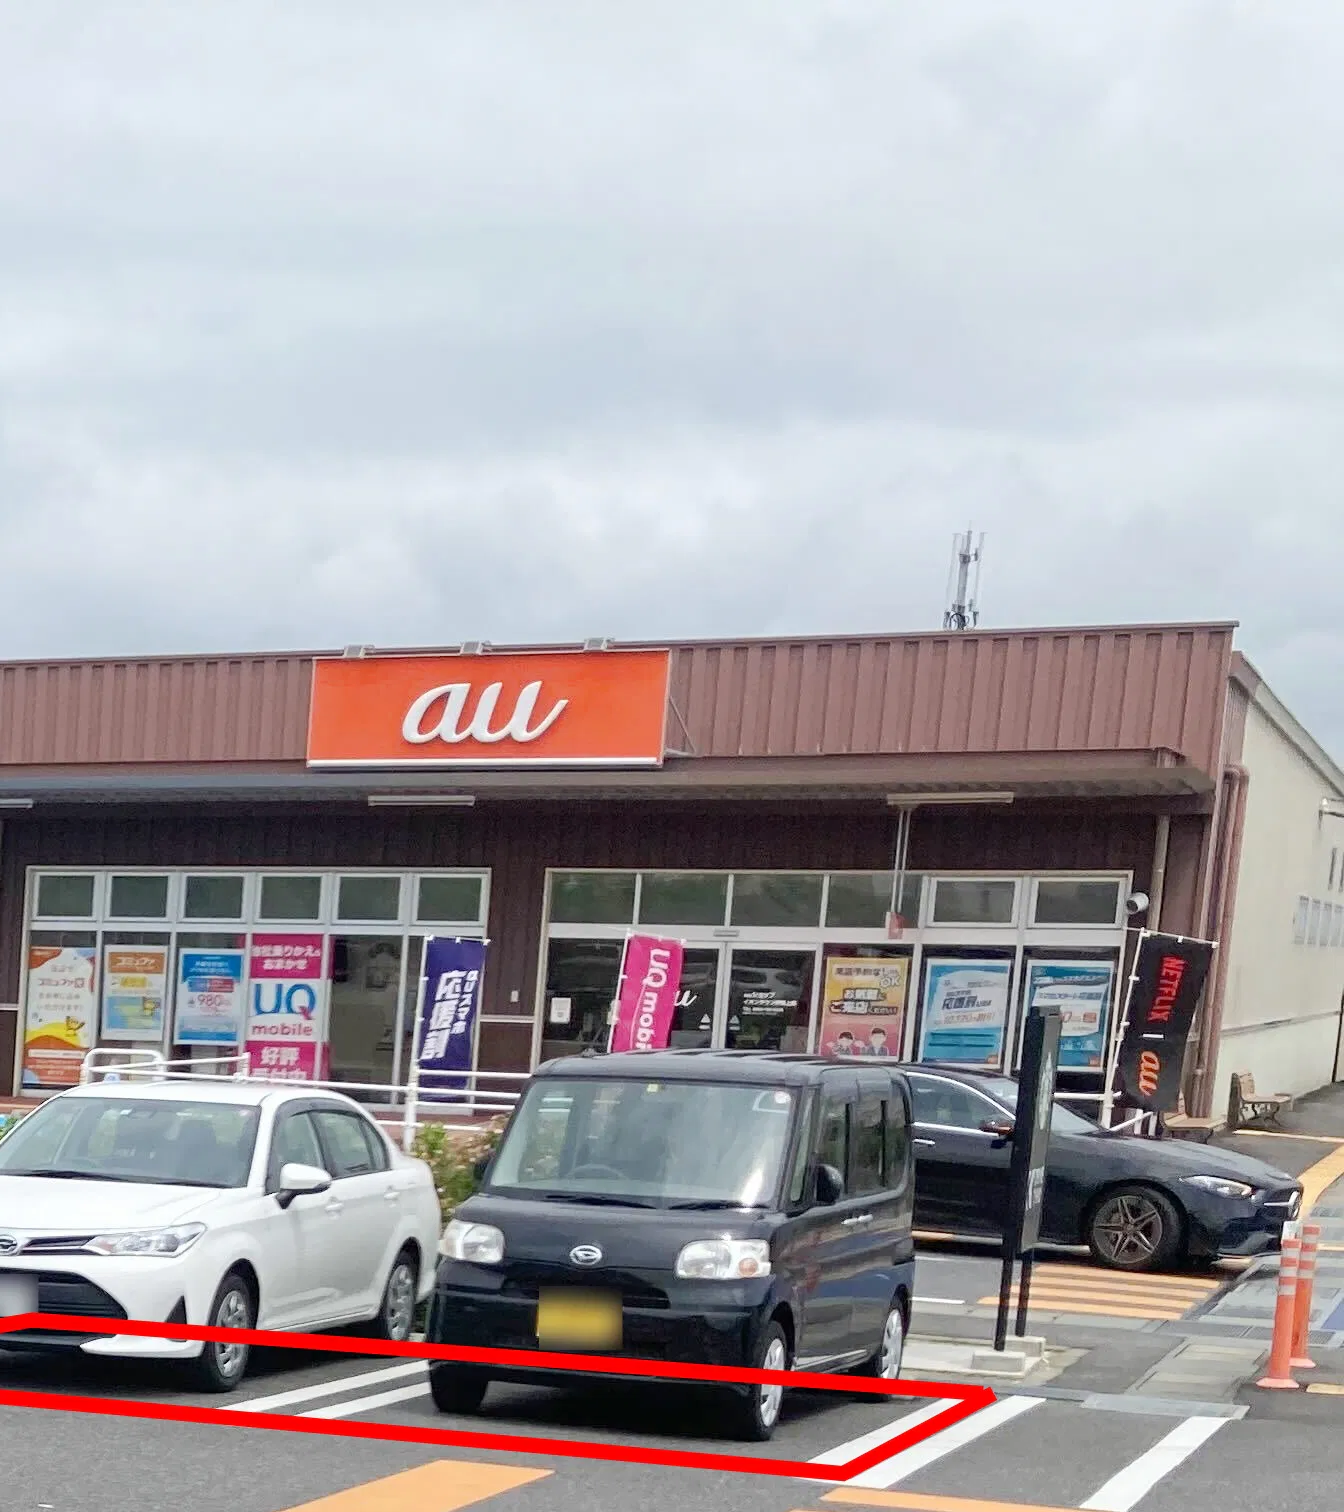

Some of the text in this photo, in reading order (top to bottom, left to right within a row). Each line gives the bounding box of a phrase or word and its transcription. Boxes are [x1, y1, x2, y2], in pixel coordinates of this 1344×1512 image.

[402, 681, 569, 744] au
[254, 983, 317, 1020] UQ
[634, 948, 671, 1050] UQ mobi
[674, 990, 698, 1007] u
[1147, 956, 1191, 1023] NETFLIX
[252, 1023, 313, 1036] mobile
[1138, 1050, 1160, 1097] au
